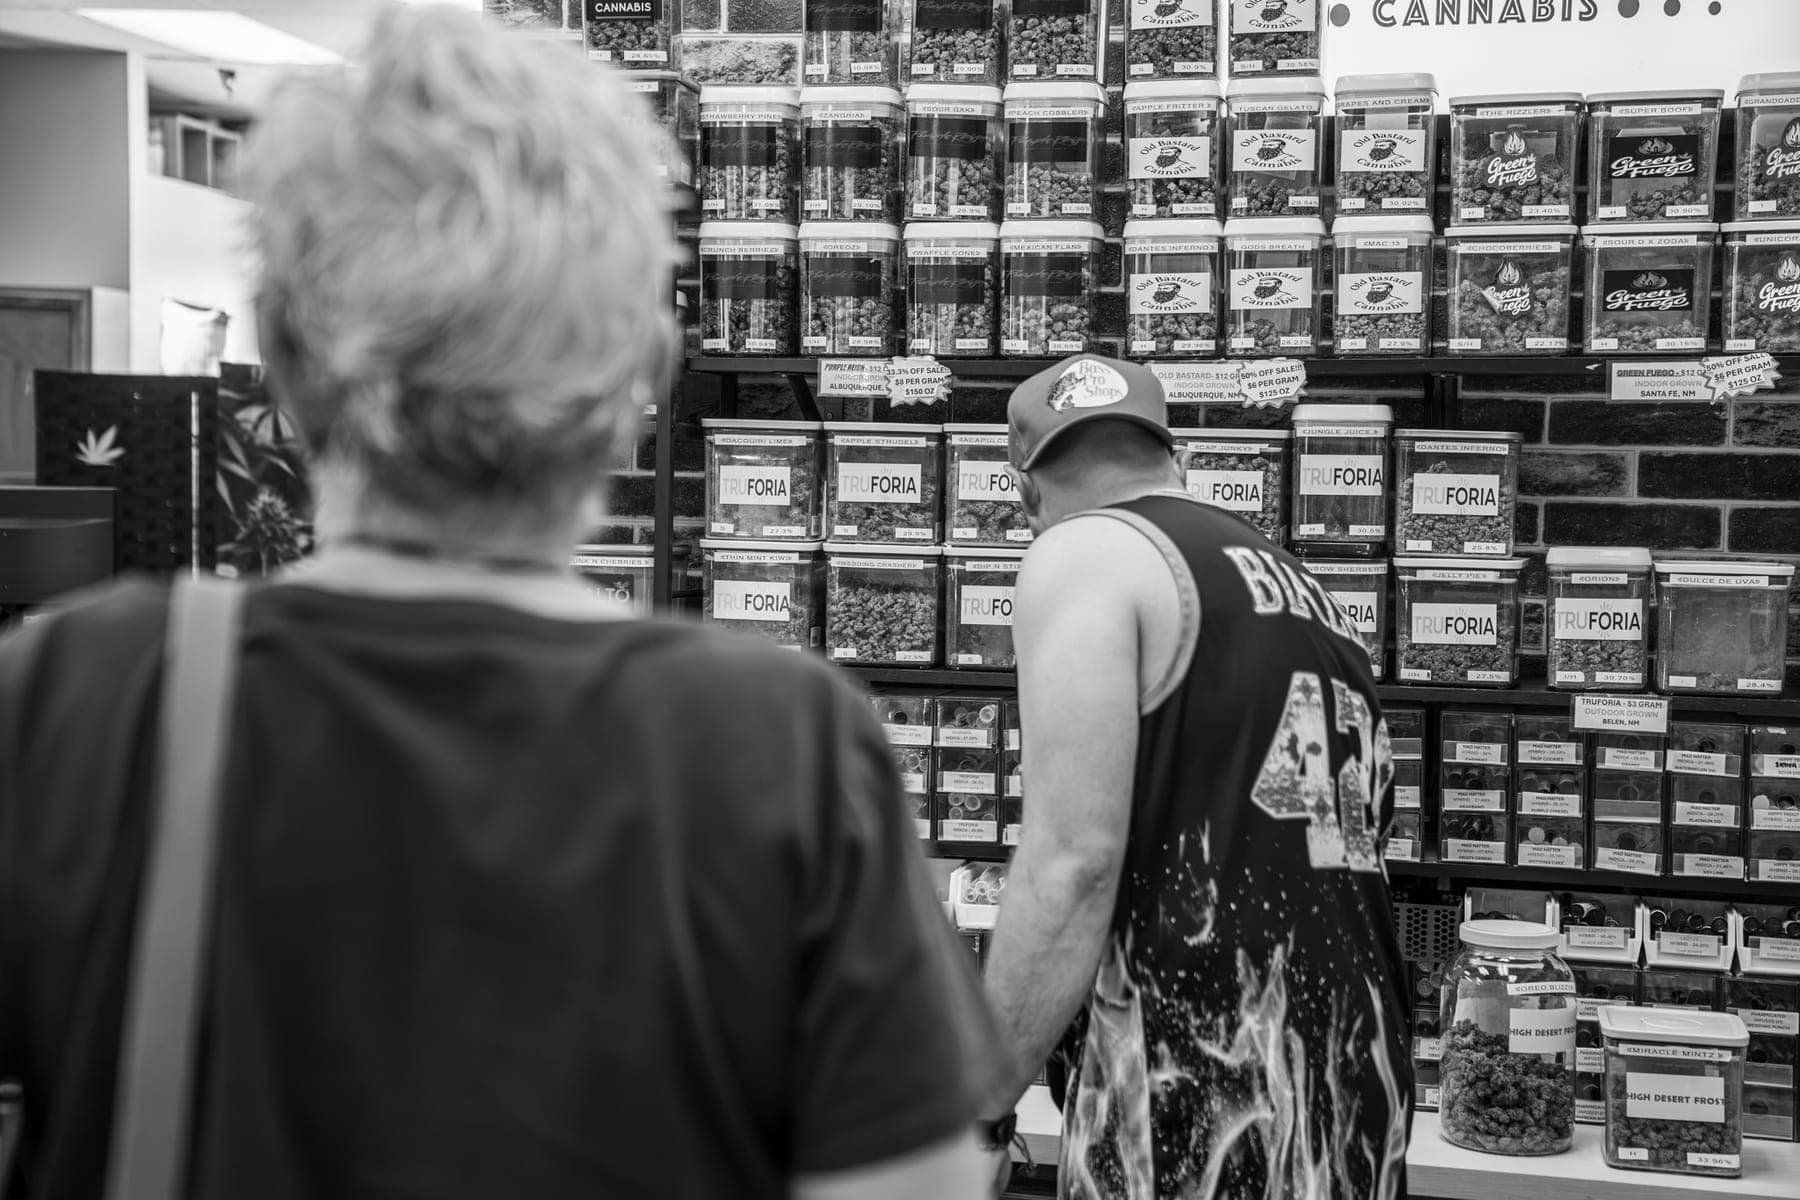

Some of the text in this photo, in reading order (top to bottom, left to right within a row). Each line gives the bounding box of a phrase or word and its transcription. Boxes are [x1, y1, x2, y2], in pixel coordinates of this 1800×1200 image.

[595, 2, 652, 13] CANNABIS
[1373, 0, 1598, 27] CANNABIS
[1142, 14, 1200, 25] Cannabis
[1248, 18, 1304, 29] Cannabis
[1011, 109, 1040, 117] PEACH
[1162, 103, 1202, 111] FRITTER
[1240, 132, 1307, 148] Old Bastard
[1353, 132, 1417, 148] Old Bastard
[1140, 139, 1202, 156] Old Bastard
[1244, 157, 1304, 169] Cannabis
[1357, 157, 1412, 169] Cannabis
[1487, 156, 1535, 176] Green
[1144, 164, 1198, 176] Cannabis
[1498, 165, 1538, 187] Fuego
[1628, 162, 1698, 178] Fuego
[1013, 243, 1053, 251] MEXICAN
[1367, 240, 1389, 248] MAC
[1136, 275, 1202, 291] Old Bastard
[1236, 271, 1303, 286] Old Bastard
[1350, 275, 1413, 291] Old Bastard
[1140, 299, 1197, 311] Cannabis
[1241, 294, 1299, 307] Cannabis
[1353, 299, 1409, 311] Cannabis
[1624, 297, 1691, 311] Fuego
[1079, 361, 1112, 375] Bass
[1706, 362, 1725, 372] 50%
[1725, 357, 1742, 367] OFF
[1726, 367, 1744, 378] PER
[1744, 360, 1772, 373] GRAM
[886, 368, 909, 376] 33.3%
[1158, 371, 1175, 379] OLD
[1215, 371, 1228, 379] $12
[1240, 363, 1304, 380] 50% OFF SALE!!!
[1616, 368, 1696, 377] GREEN FUEGO $12
[921, 376, 945, 384] GRAM
[1083, 374, 1106, 387] Pro
[1247, 375, 1300, 390] $6 PER GRAM
[1635, 380, 1703, 388] INDOOR GROWN
[1728, 374, 1763, 389] $125 OZ
[905, 387, 936, 396] $150 OZ
[1085, 384, 1124, 400] Shops
[1168, 391, 1227, 399] ALBUQUERQUE,
[1258, 387, 1291, 398] $125 OZ
[1640, 390, 1696, 398] SANTA FE, NM
[1307, 428, 1371, 436] JUNGLE JUICE
[846, 437, 872, 445] APPLE
[961, 473, 1017, 492] TRUFO
[1302, 467, 1384, 487] TRUFORIA
[723, 477, 788, 497] TRUFORIA
[842, 475, 917, 495] TRUFORIA
[1187, 482, 1261, 502] RUFORIA
[1414, 486, 1497, 506] TRUFORIA
[1715, 577, 1729, 585] DE
[1734, 578, 1757, 586] UVA
[715, 592, 791, 613] TRUFORIA
[963, 598, 1013, 618] TRUFO
[1413, 615, 1496, 637] TRUFORIA
[1556, 610, 1642, 631] TRUFORIA
[1581, 698, 1621, 707] TRUFORIA
[1637, 701, 1663, 710] GRAM
[1584, 707, 1659, 719] OUTDOOR GROWN
[1602, 717, 1641, 727] BELEN, NM
[1509, 1027, 1562, 1037] HIGH DESERT
[1630, 1047, 1715, 1059] MIRACLE MINTZ
[1627, 1092, 1725, 1106] HIGH DESERT FROST
